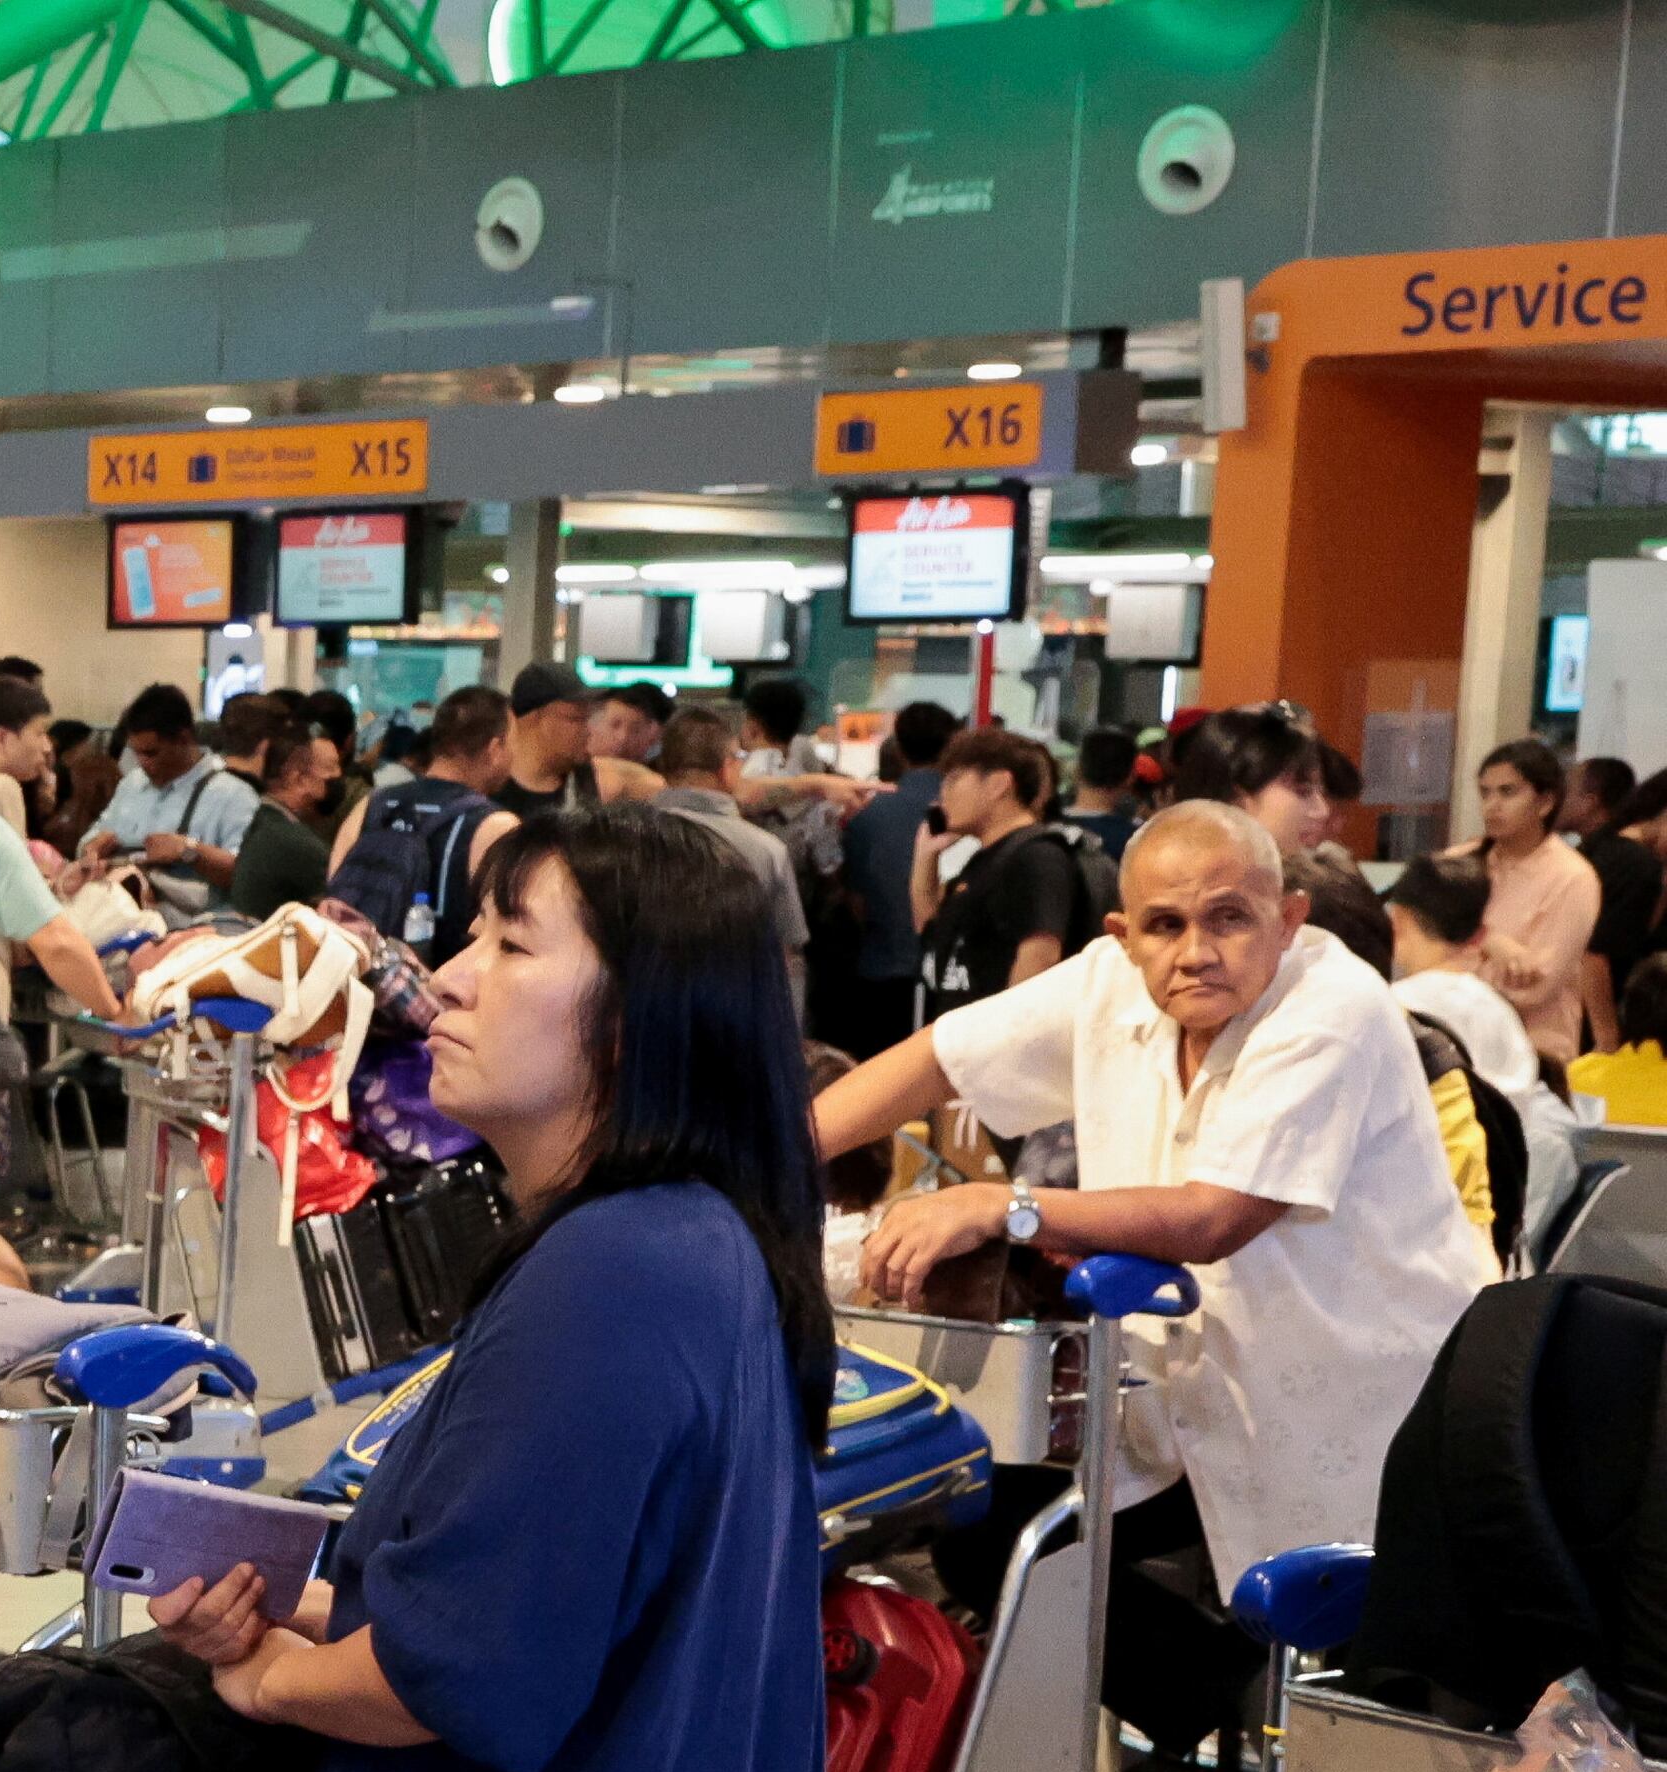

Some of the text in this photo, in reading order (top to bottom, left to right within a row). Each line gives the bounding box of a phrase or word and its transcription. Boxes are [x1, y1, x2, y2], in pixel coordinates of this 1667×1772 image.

[1402, 263, 1648, 337] Service
[944, 402, 1022, 449] X16
[102, 451, 158, 488] X14
[349, 436, 412, 477] X15
